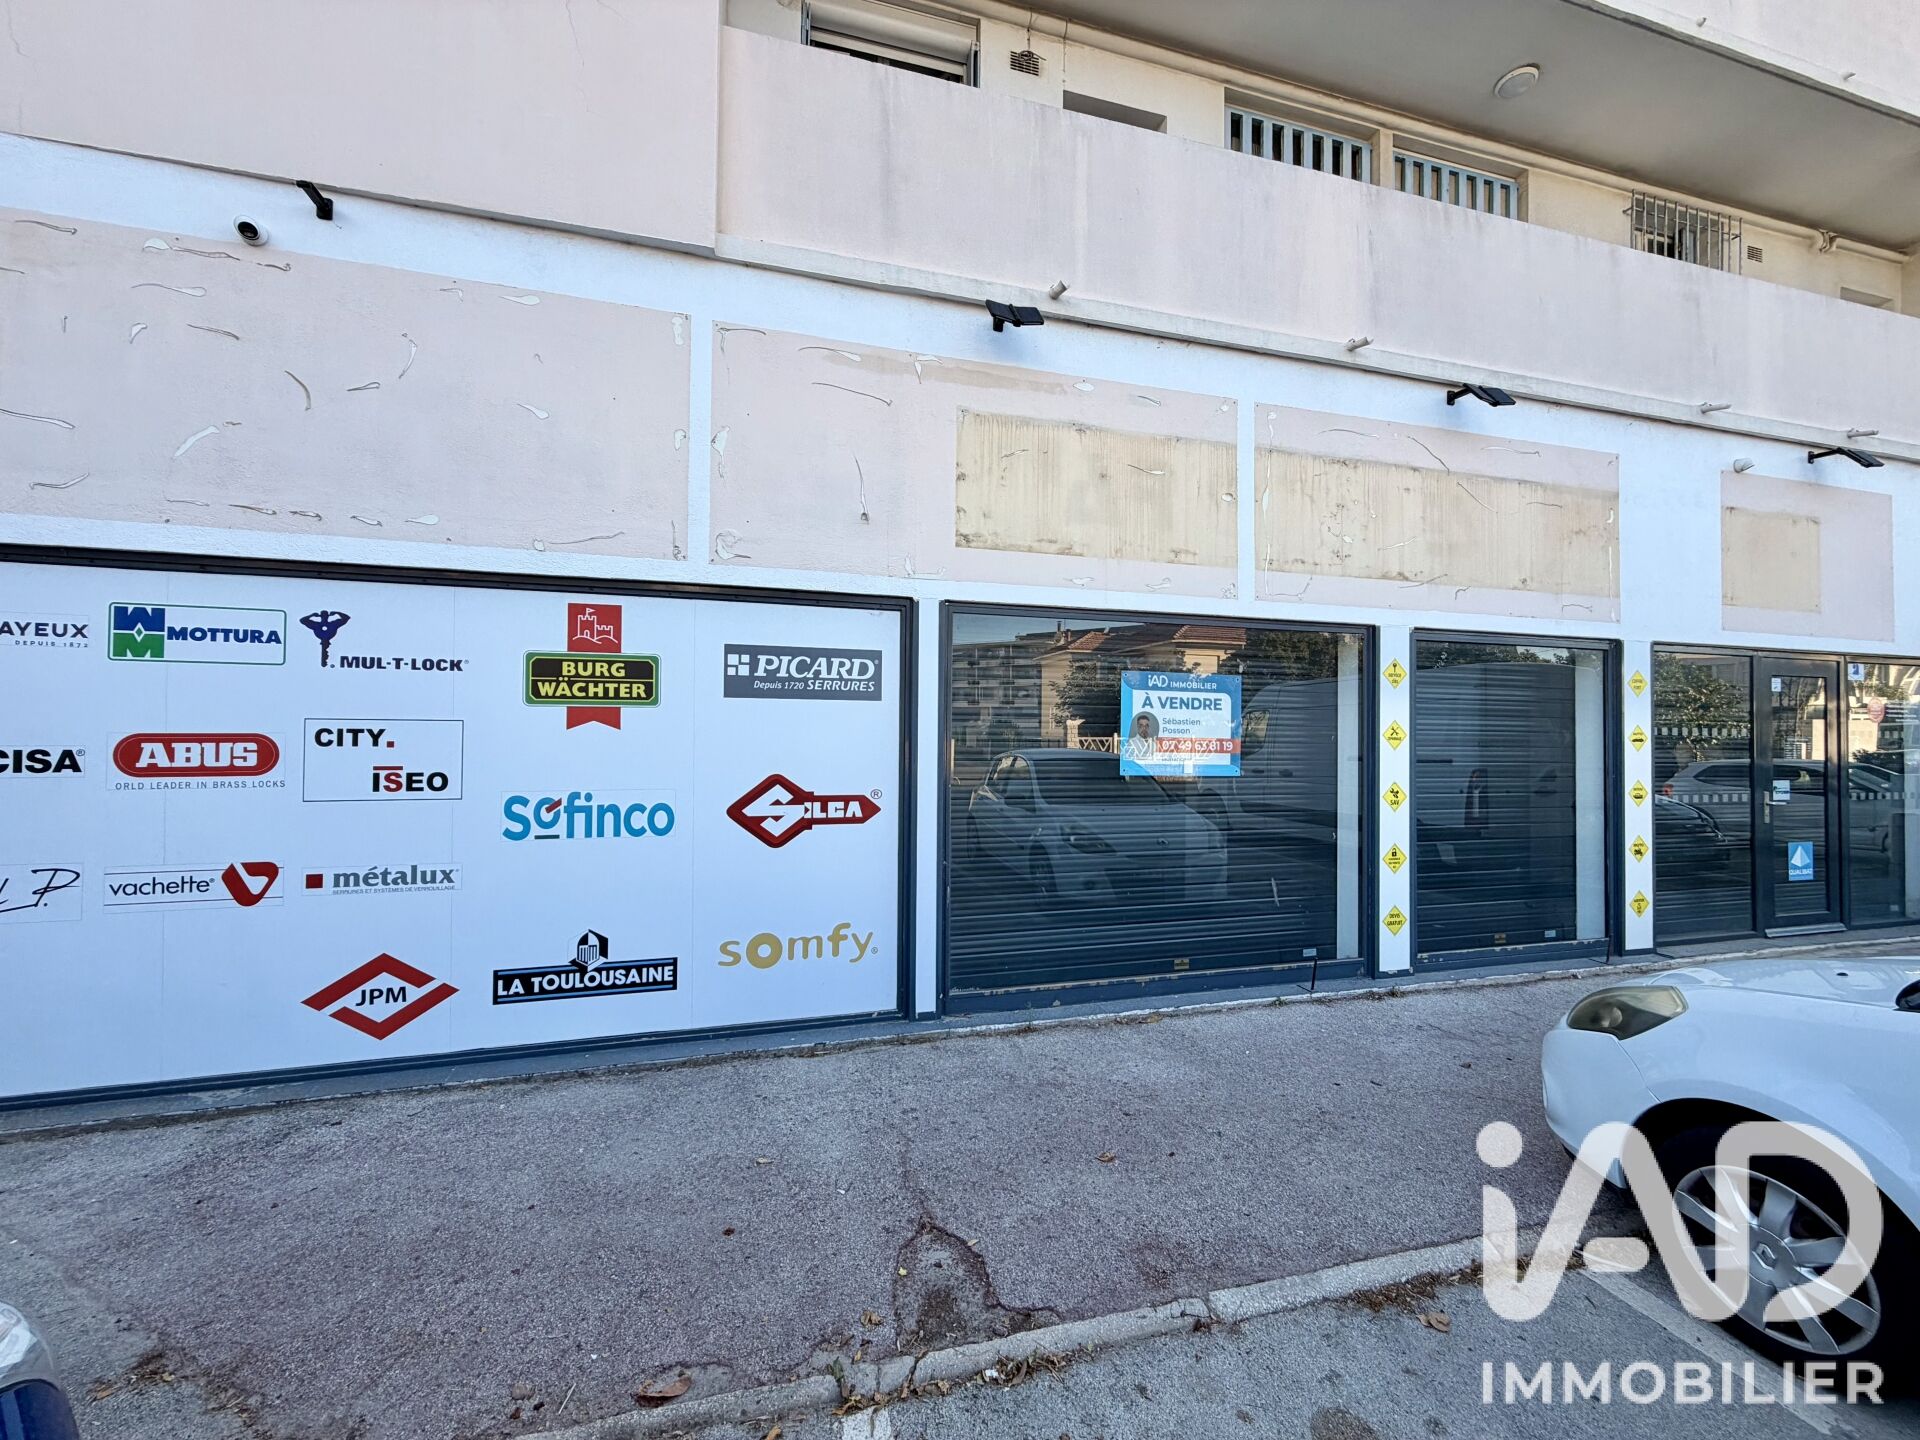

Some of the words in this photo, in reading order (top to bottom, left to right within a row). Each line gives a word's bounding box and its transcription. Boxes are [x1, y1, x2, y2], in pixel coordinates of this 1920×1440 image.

[166, 626, 282, 645] MOTTURA
[339, 655, 464, 672] MUL-T-LOCK
[561, 660, 626, 678] BURG
[754, 654, 876, 680] PICARD
[537, 677, 647, 699] WÄCHTER
[753, 680, 783, 691] Depuis
[784, 680, 805, 690] 1720
[806, 679, 876, 692] SERRURES
[1170, 681, 1217, 690] IMMOBILIER
[1141, 692, 1154, 709] À
[1157, 696, 1223, 711] VENDRE
[1162, 718, 1201, 726] Sébastien
[135, 742, 258, 768] ABUS
[1222, 741, 1233, 750] 19
[150, 781, 192, 790] LEADER
[196, 781, 208, 789] IN
[212, 781, 247, 789] BRASS
[252, 780, 286, 788] LOCKS
[371, 769, 450, 793] ISEO
[501, 791, 676, 841] Sofinco
[109, 874, 211, 897] vachette
[332, 865, 456, 888] métalux
[717, 922, 874, 969] somfy
[497, 977, 525, 997] LA
[531, 965, 674, 992] TOULOUSAINE
[355, 986, 408, 1007] JPM
